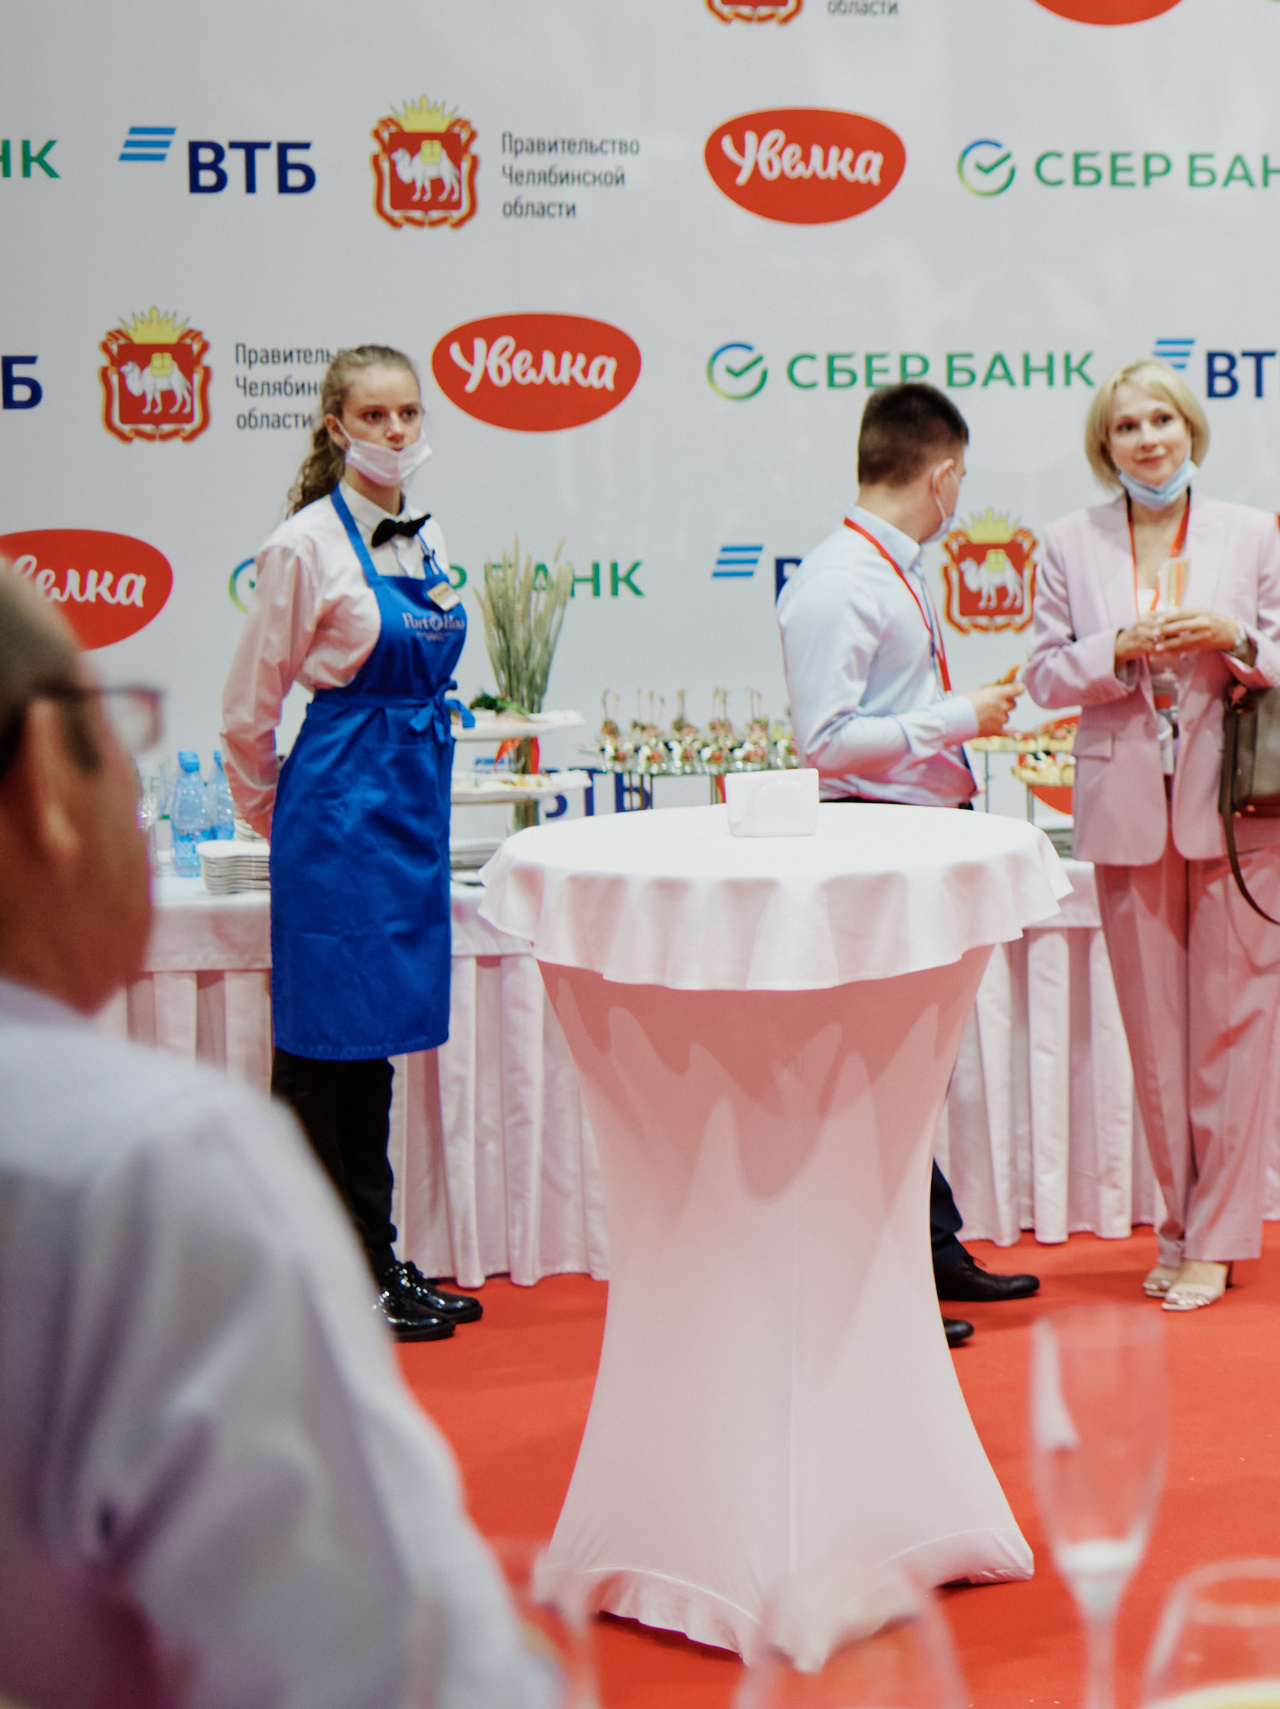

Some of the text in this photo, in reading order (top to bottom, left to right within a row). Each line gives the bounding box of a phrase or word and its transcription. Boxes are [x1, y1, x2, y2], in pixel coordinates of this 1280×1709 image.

[501, 131, 640, 159] Правительство
[722, 129, 884, 187] Увелка
[188, 141, 316, 194] ВТБ
[501, 164, 626, 187] Челябинской
[1033, 151, 1172, 188] СБЕР
[502, 195, 577, 218] области
[235, 342, 332, 369] Правител
[449, 335, 618, 393] Увелка
[787, 352, 1095, 388] СБЕР БАНК
[235, 375, 321, 397] Челябин
[236, 407, 314, 430] области
[12, 554, 146, 608] елка
